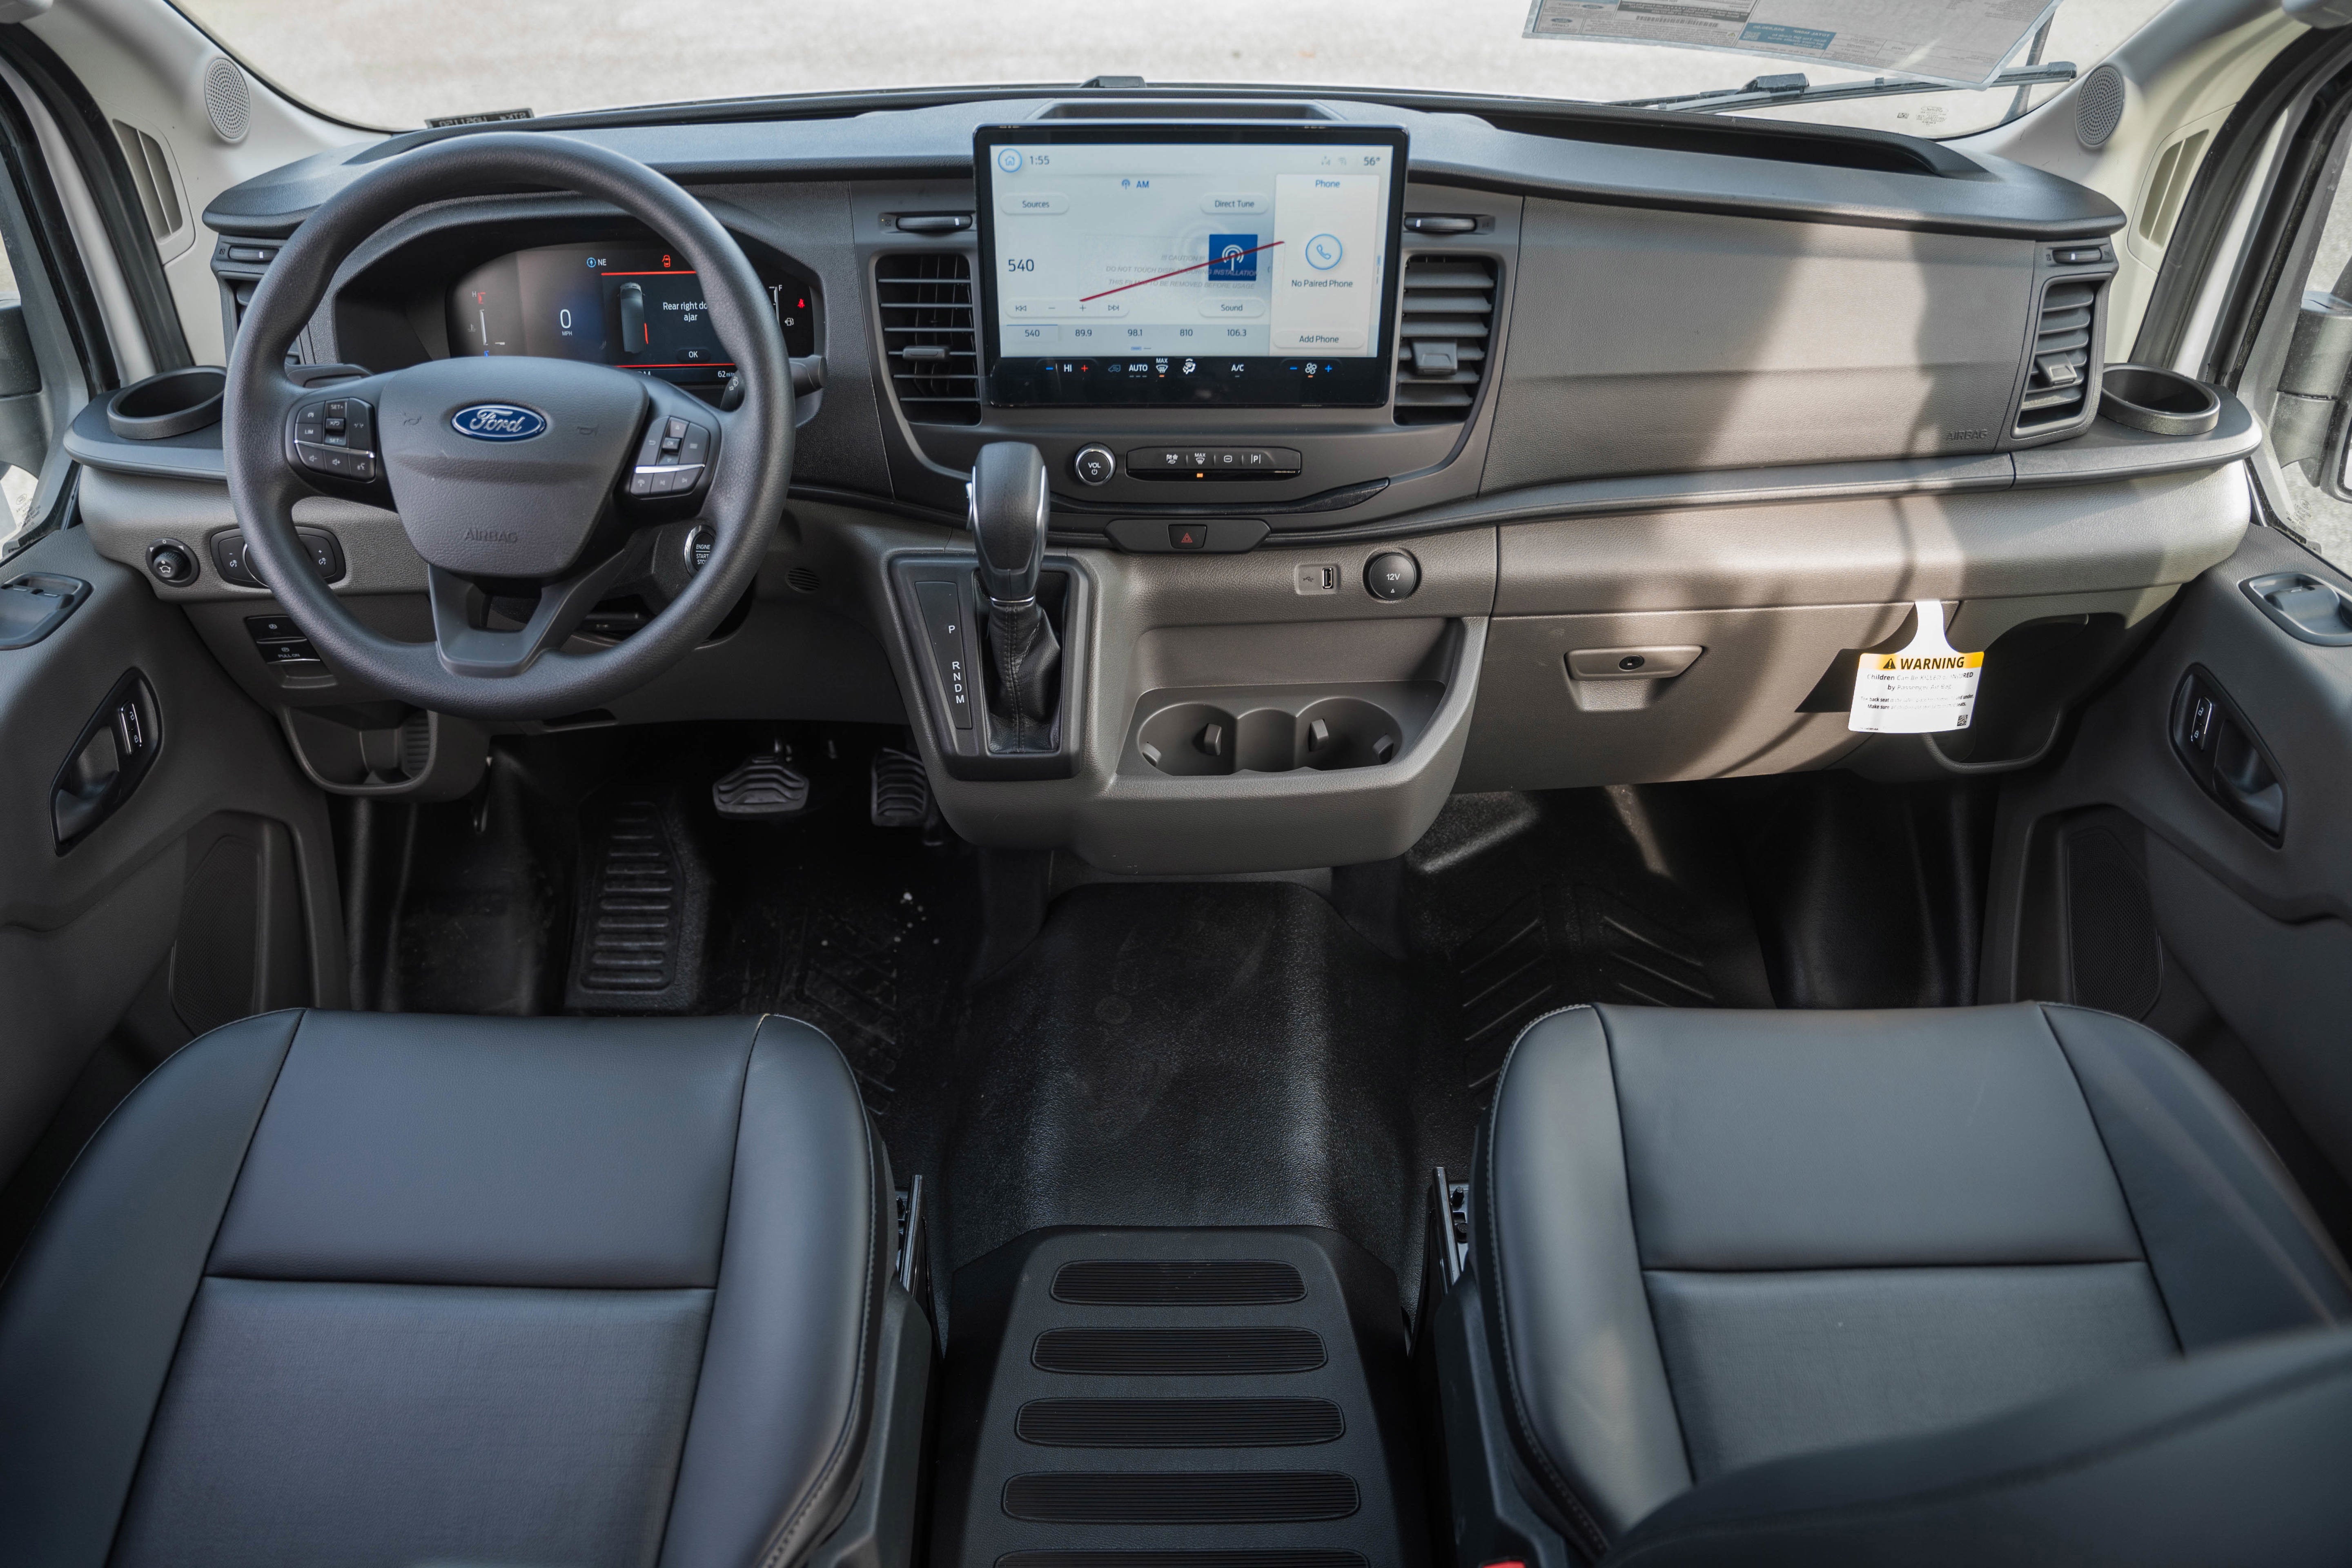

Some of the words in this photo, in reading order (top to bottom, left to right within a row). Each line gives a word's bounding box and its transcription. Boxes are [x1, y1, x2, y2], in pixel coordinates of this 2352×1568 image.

[1029, 155, 1050, 165] 1:55
[1363, 156, 1381, 166] 56°
[1136, 180, 1149, 189] AM
[1315, 180, 1340, 188] Phone
[1022, 200, 1050, 208] Sources
[1008, 258, 1034, 272] 540
[1303, 279, 1327, 287] Paired
[1329, 279, 1353, 287] Phone
[663, 302, 679, 310] Rear
[681, 301, 698, 311] right
[699, 301, 708, 310] do
[560, 309, 572, 329] 0
[684, 313, 698, 322] ajar
[1025, 329, 1040, 337] 540
[469, 408, 526, 433] Ford
[1946, 430, 1988, 440] AIRBAG
[465, 529, 519, 543] AIRBAG
[948, 625, 956, 633] P
[952, 661, 960, 670] R
[1900, 657, 1965, 670] WARNING
[953, 672, 961, 681] N
[954, 684, 962, 693] D
[956, 695, 965, 704] M
